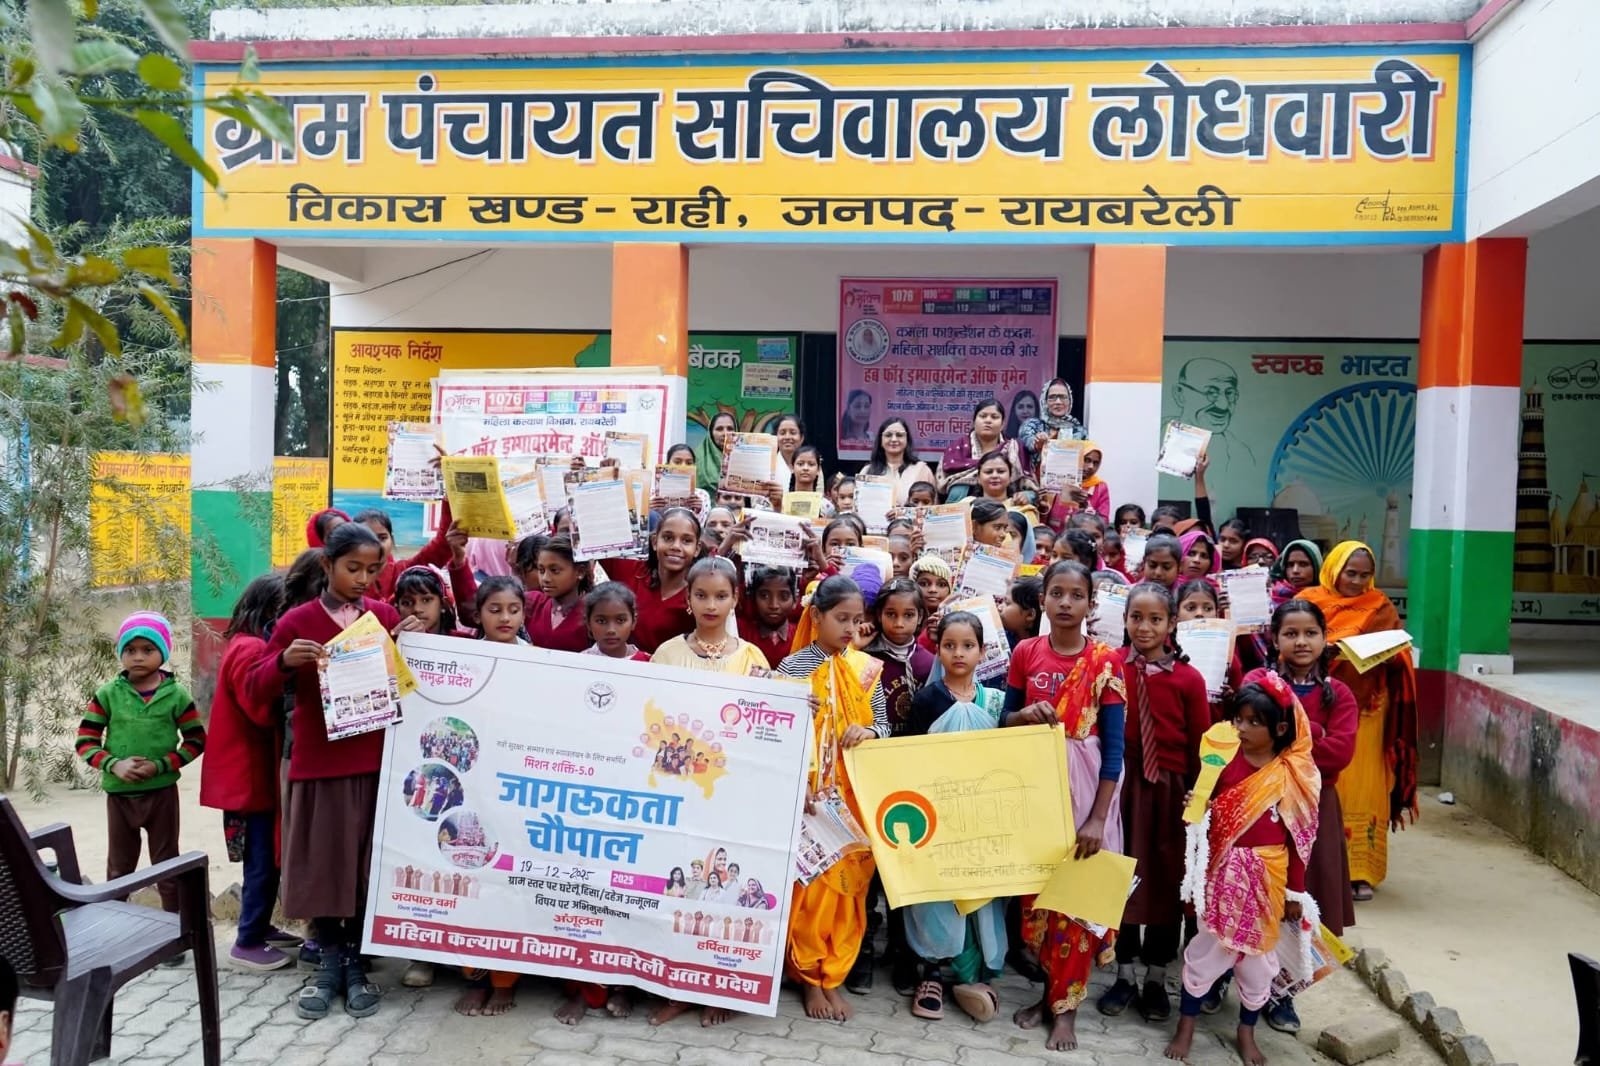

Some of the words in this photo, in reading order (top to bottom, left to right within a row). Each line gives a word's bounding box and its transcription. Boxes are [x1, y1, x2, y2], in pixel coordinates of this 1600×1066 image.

[214, 92, 367, 168] ग्राम
[384, 72, 662, 164] पंचायत
[675, 68, 1069, 165] सचिवालय
[1089, 59, 1440, 161] लोधवारी
[287, 182, 446, 223] विकास
[1000, 185, 1241, 227] रायबरेली
[892, 340, 923, 356] महिला
[1000, 341, 1016, 357] की
[1252, 353, 1324, 376] स्वच्छ
[1340, 354, 1411, 377] भारत
[863, 367, 880, 384] हब
[489, 392, 522, 405] 1076
[483, 415, 511, 427] महिला
[512, 418, 543, 427] कल्याण
[580, 416, 617, 427] रायबरेली
[916, 419, 945, 438] पूनम
[406, 656, 434, 672] सशक्त
[437, 660, 458, 675] नारी
[447, 672, 473, 688] प्रदेश
[524, 755, 549, 771] मिशन
[496, 772, 684, 826] जागरूकता
[525, 812, 644, 864] चौपाल
[612, 874, 634, 885] 2025
[391, 892, 433, 906] जयपाल
[436, 897, 456, 910] वर्मा
[508, 875, 525, 886] ग्राम
[527, 878, 544, 890] स्तर
[545, 881, 558, 891] पर
[625, 897, 660, 910] उन्मूलन
[558, 900, 569, 910] पर
[384, 921, 445, 944] महिला
[447, 931, 519, 954] कल्याण
[521, 936, 583, 965] विभाग,
[589, 949, 667, 977] रायबरेली
[668, 966, 713, 987] उत्तर
[715, 972, 761, 995] प्रदेश
